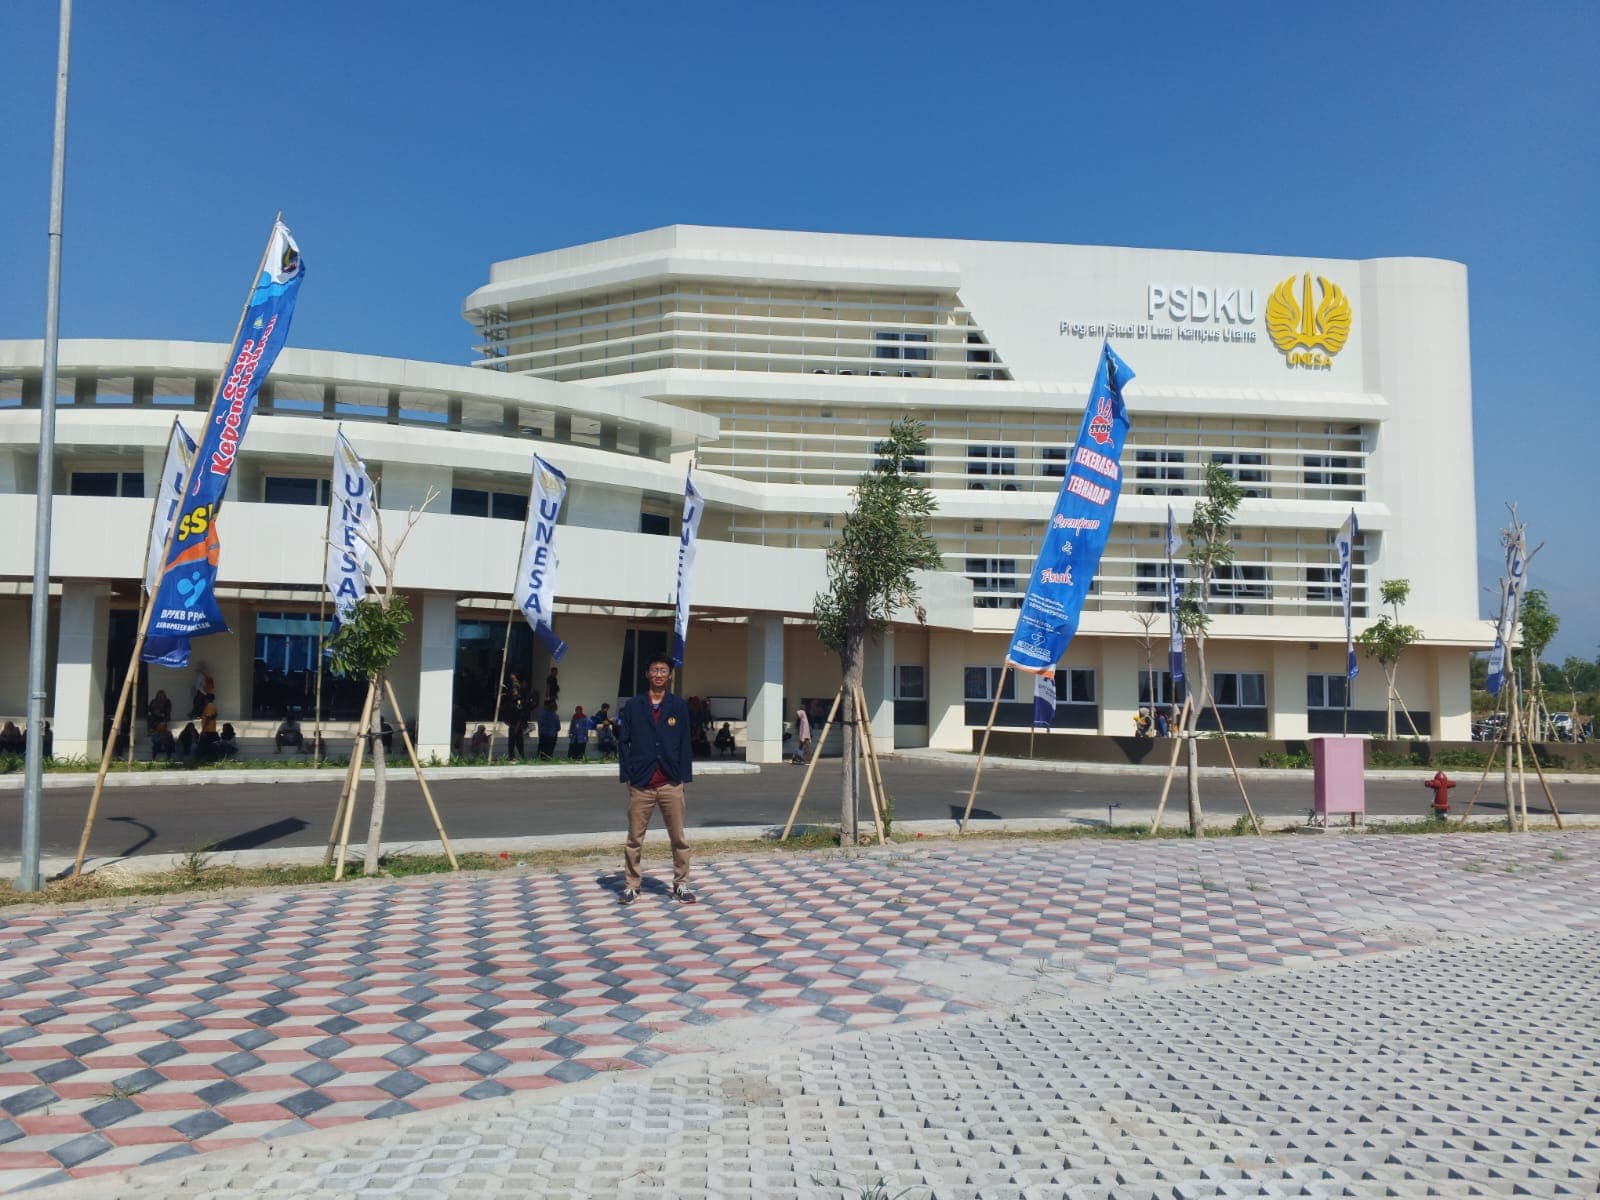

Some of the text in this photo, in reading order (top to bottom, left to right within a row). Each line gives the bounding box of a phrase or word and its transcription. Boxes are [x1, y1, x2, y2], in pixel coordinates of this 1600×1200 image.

[1148, 282, 1257, 323] PSDKU
[1286, 351, 1333, 371] UNESA
[1090, 423, 1111, 433] STOP
[1067, 475, 1112, 506] TERHADAP
[336, 473, 364, 599] UNESA
[524, 498, 557, 614] UNESA
